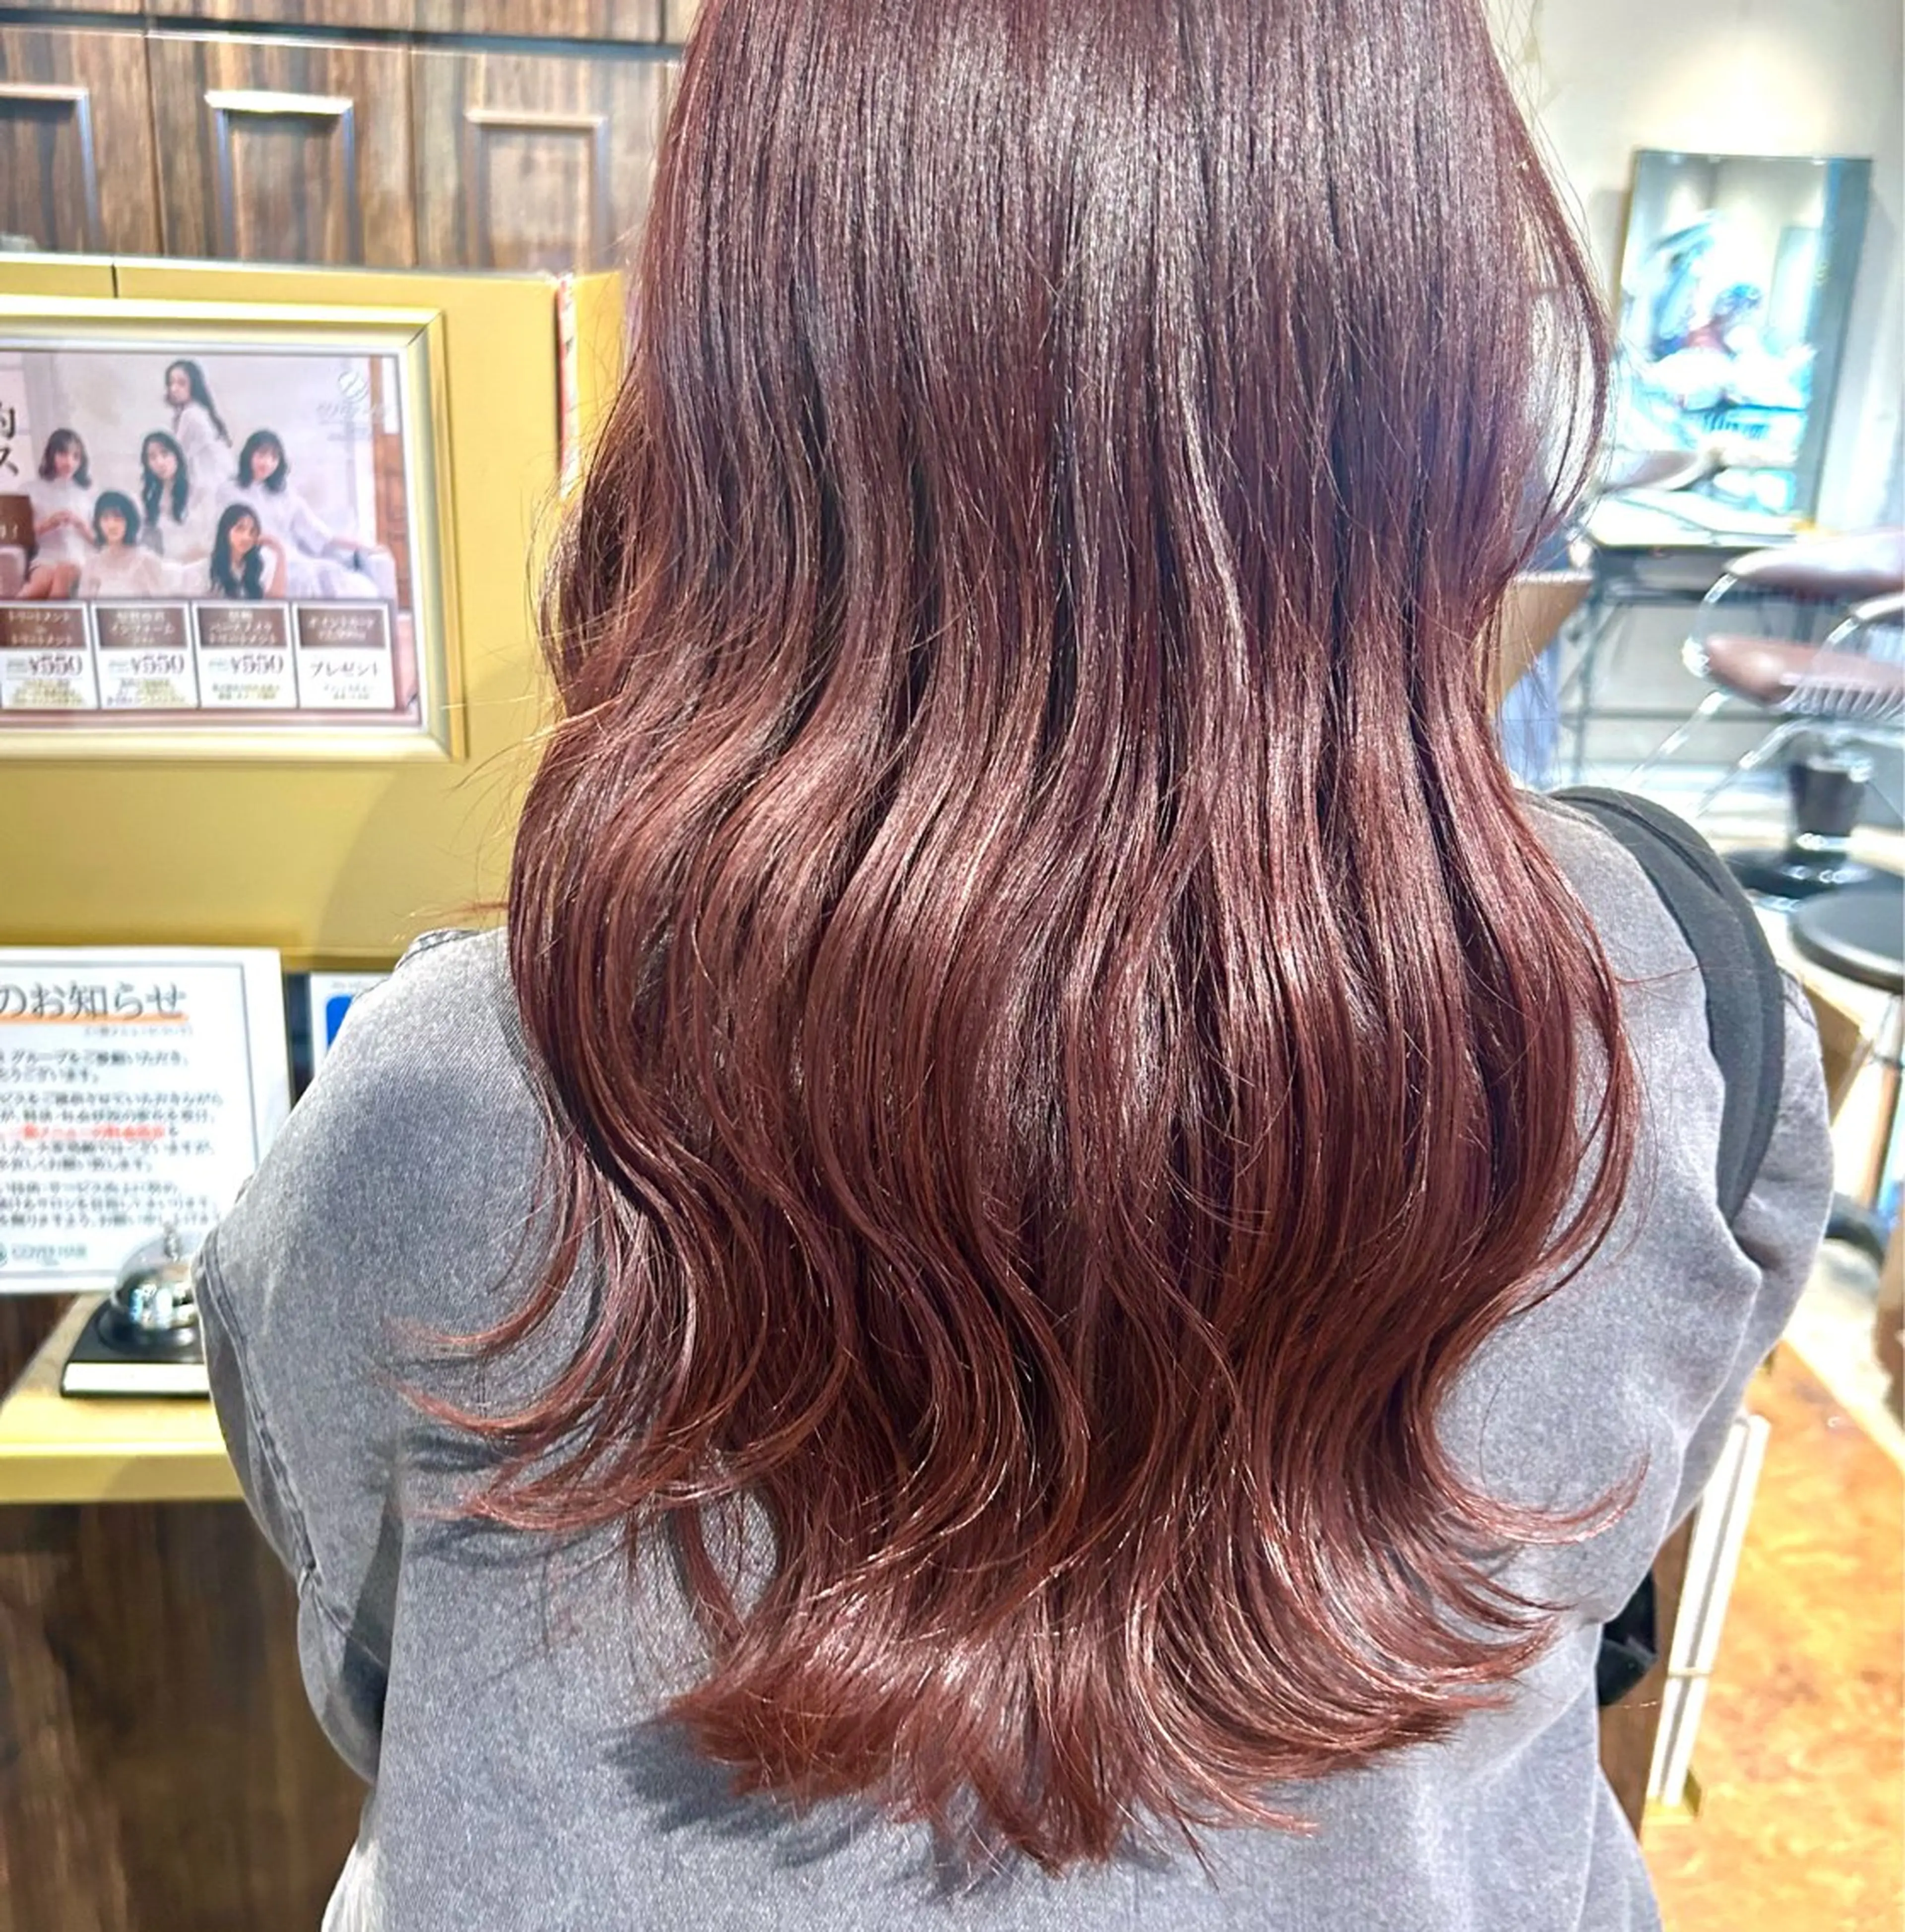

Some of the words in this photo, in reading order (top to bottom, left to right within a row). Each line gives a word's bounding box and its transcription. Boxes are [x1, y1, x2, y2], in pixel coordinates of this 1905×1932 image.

[310, 659, 379, 678] プレゼント
[0, 980, 187, 1021] のお知らせ
